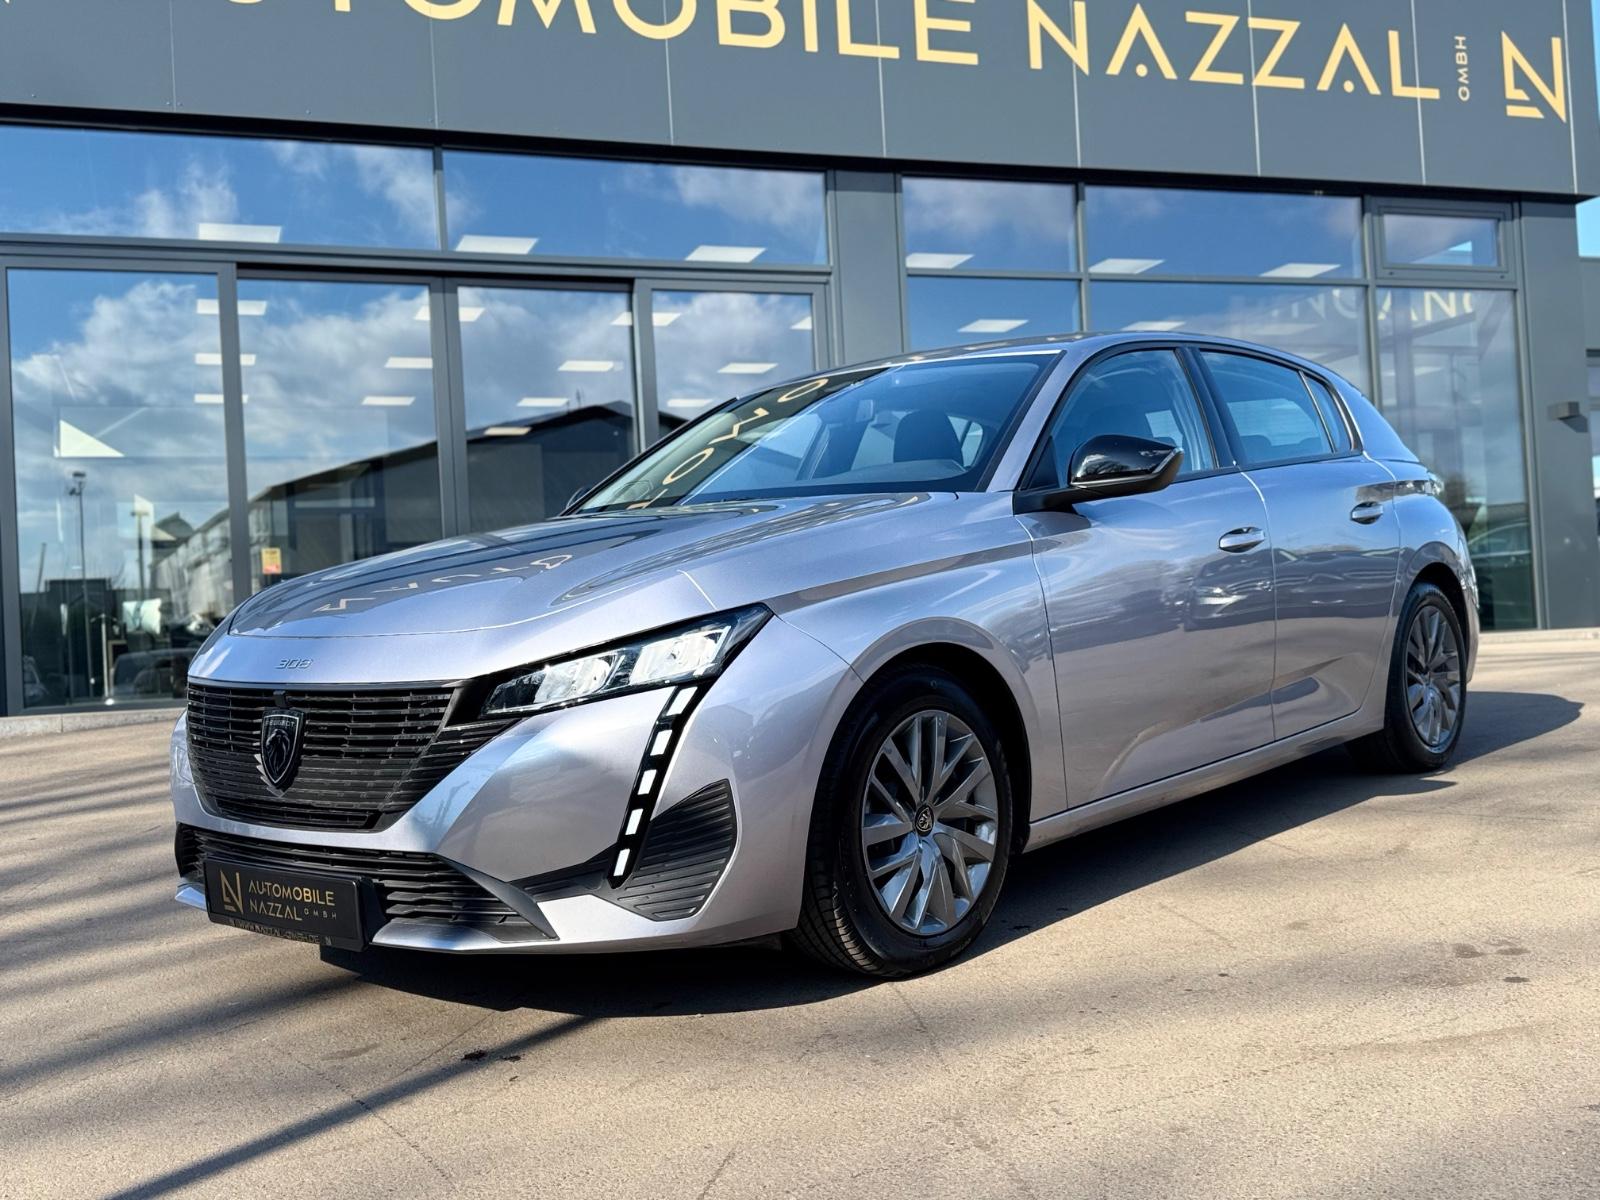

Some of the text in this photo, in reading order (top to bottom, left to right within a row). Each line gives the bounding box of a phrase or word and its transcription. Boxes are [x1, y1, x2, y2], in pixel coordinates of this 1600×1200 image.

[1026, 0, 1441, 100] NAZZAL
[1454, 35, 1470, 101] GMBH
[275, 658, 313, 669] 308
[249, 879, 335, 906] AUTOMOBILE
[249, 899, 303, 921] NAZZAL
